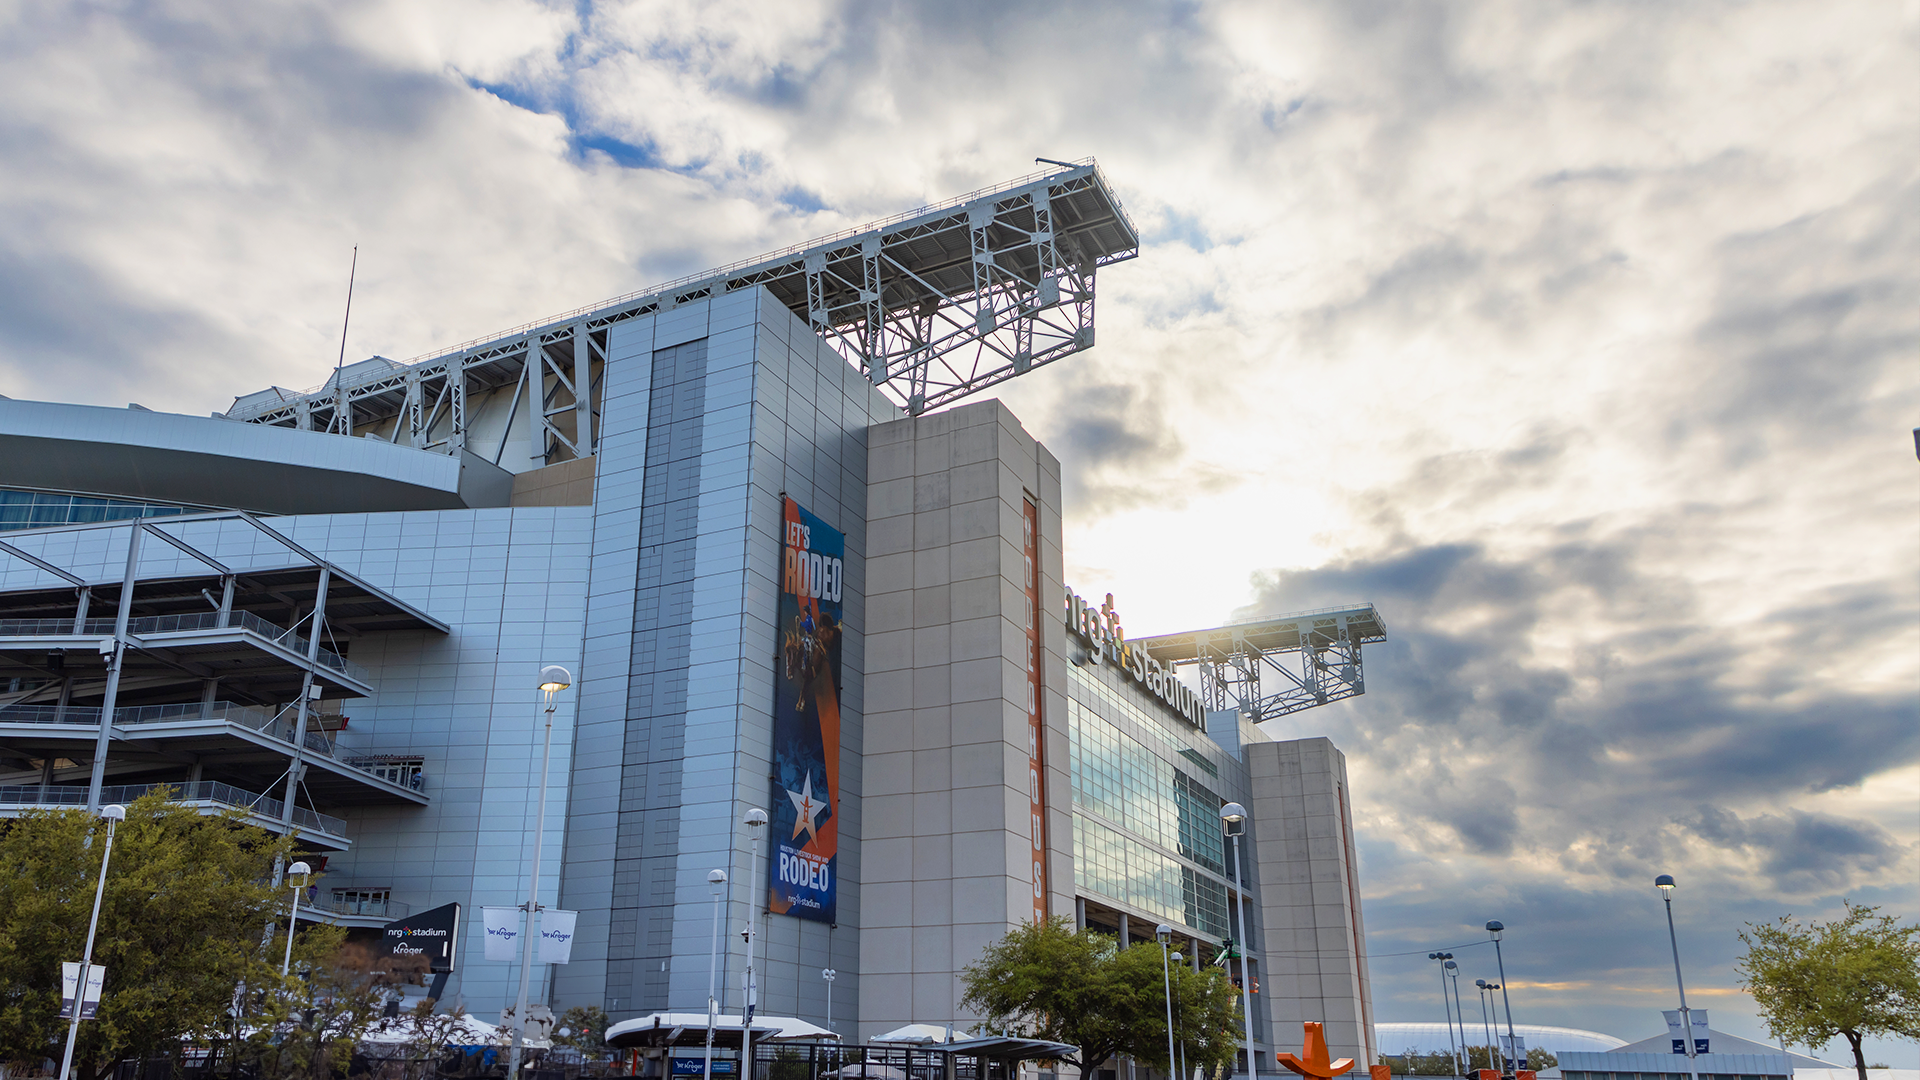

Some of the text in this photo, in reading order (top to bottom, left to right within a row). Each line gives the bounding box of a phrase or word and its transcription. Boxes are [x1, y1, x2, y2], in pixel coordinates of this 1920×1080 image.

[786, 520, 811, 550] LET'S
[784, 546, 843, 604] RODEO
[1064, 586, 1208, 735] nrg stadium
[779, 852, 829, 892] RODEO
[787, 895, 821, 909] nrg stadium
[388, 927, 447, 938] nrg stadium
[496, 927, 517, 940] Kroger
[550, 929, 571, 942] Kroger
[393, 942, 423, 955] Kroger
[684, 1060, 703, 1073] Kroger
